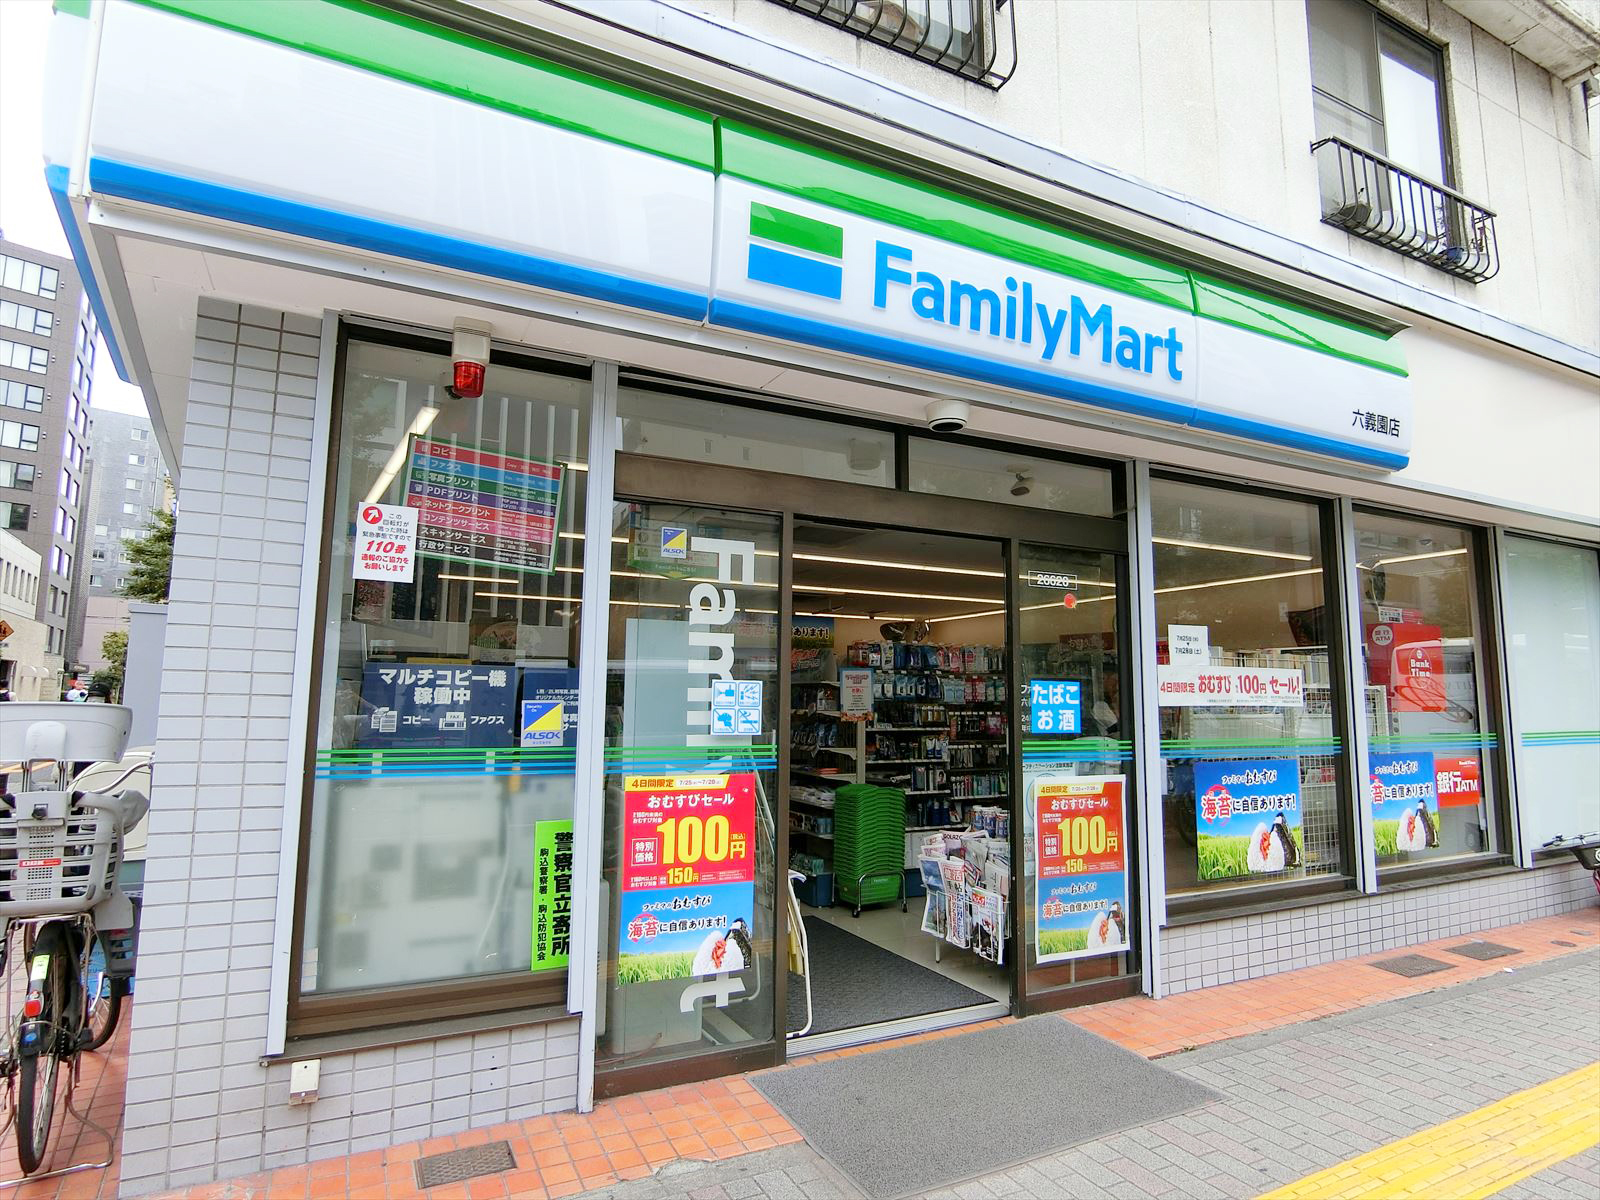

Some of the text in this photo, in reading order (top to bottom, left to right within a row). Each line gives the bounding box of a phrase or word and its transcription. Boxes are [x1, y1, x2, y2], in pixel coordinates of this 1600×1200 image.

[873, 239, 1183, 382] FamilyMart
[1352, 409, 1400, 438] 六義園店
[426, 486, 479, 501] PDFプリント
[366, 540, 407, 554] 110番
[364, 562, 406, 572] お願いします
[1410, 659, 1430, 668] Bank
[379, 668, 507, 687] マルチコピー機
[1411, 668, 1430, 677] Time
[1160, 682, 1195, 693] 4日間限定
[1198, 675, 1232, 694] おむすび
[413, 687, 471, 704] 稼働中
[1032, 683, 1080, 705] たばこ
[402, 715, 431, 725] コピー
[470, 715, 505, 725] ファクス
[1037, 709, 1075, 731] お酒
[524, 731, 561, 740] ALSOK
[631, 779, 674, 788] 4日間限定
[648, 793, 735, 808] おむすびセール
[1372, 782, 1434, 804] 苔に自信あります!
[1051, 797, 1109, 810] おむすびセール
[1202, 793, 1297, 818] 海苔に自信あります!
[551, 831, 574, 957] 警察官立寄所
[628, 916, 727, 938] 海苔に自信あります!
